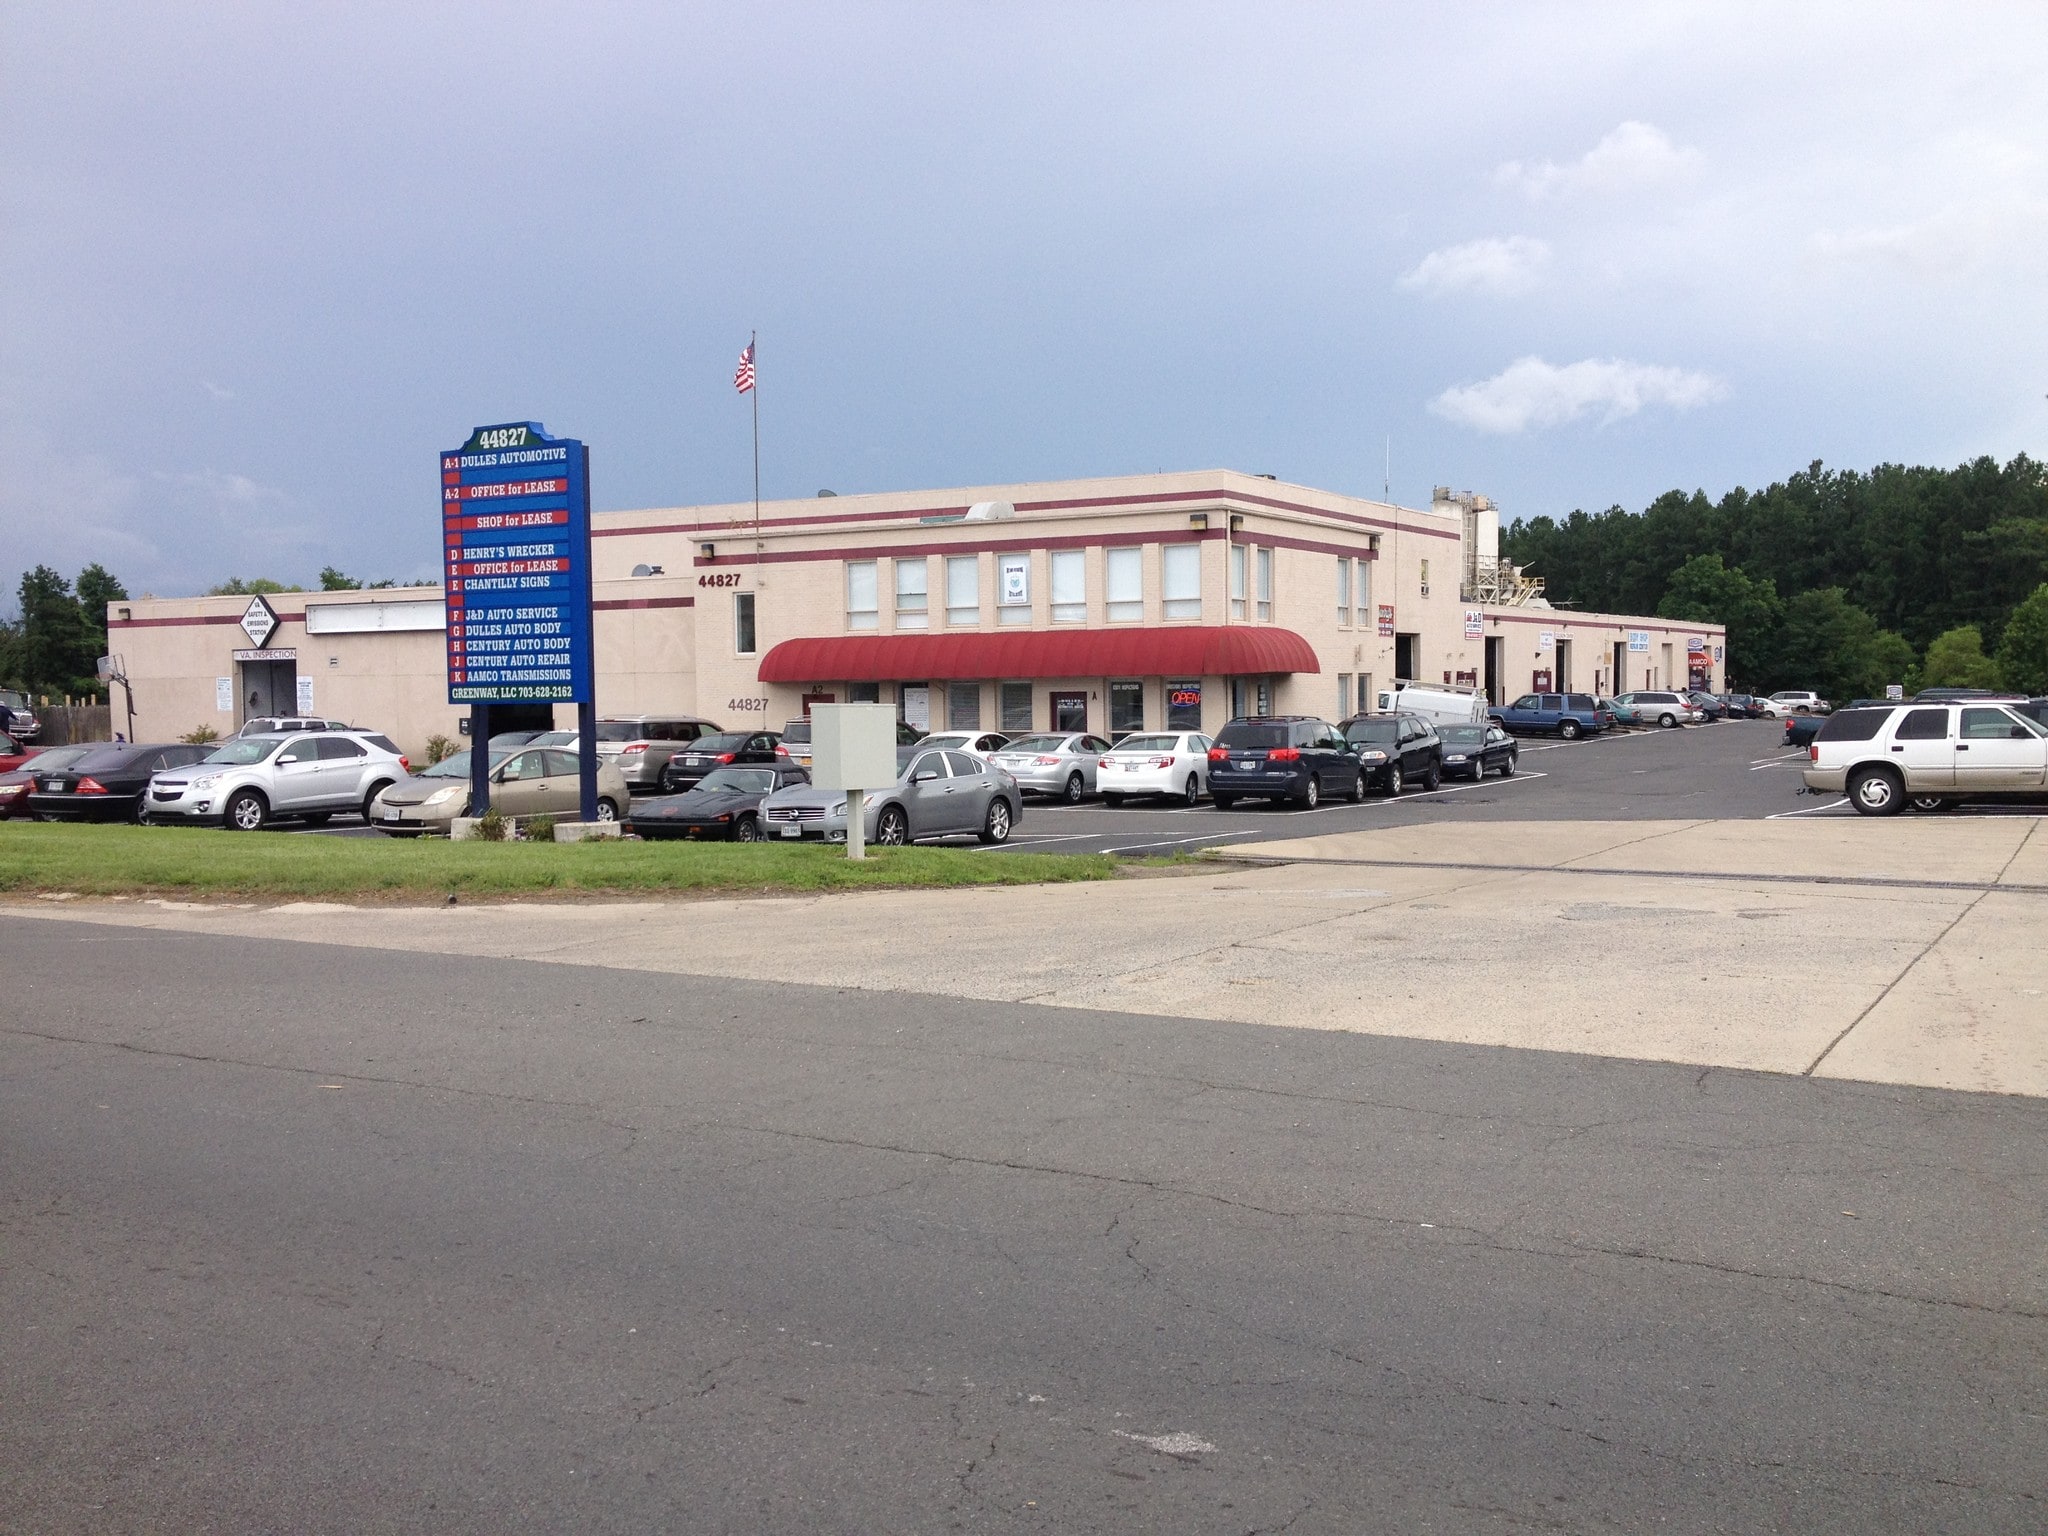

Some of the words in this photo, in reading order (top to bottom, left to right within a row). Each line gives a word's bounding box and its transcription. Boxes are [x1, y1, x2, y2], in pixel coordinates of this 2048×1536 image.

[480, 428, 527, 449] 44827
[445, 458, 459, 468] A-1
[461, 454, 496, 467] DULLES
[500, 448, 566, 464] AUTOMOTIVE
[445, 489, 459, 499] A-2
[471, 485, 505, 498] OFFICE
[509, 484, 521, 495] for
[525, 481, 556, 493] LEASE
[477, 517, 503, 528] SHOP
[506, 516, 518, 526] for
[522, 513, 552, 525] LEASE
[452, 550, 458, 560] D
[463, 547, 504, 559] HENRY'S
[508, 544, 555, 557] WRECKER
[452, 565, 458, 575] E
[474, 564, 508, 575] OFFICE
[511, 562, 524, 573] for
[528, 561, 558, 571] LEASE
[453, 580, 458, 591] E
[465, 578, 518, 590] CHANTILLY
[521, 576, 550, 588] SIGNS
[699, 574, 741, 587] 44827
[453, 611, 459, 621] F
[466, 610, 484, 621] J&D
[487, 609, 513, 620] AUTO
[516, 608, 558, 619] SERVICE
[454, 626, 460, 636] G
[466, 625, 502, 636] DULLES
[505, 624, 531, 635] AUTO
[534, 623, 561, 634] BODY
[454, 642, 460, 651] H
[466, 640, 511, 651] CENTURY
[514, 639, 541, 650] AUTO
[544, 638, 571, 650] BODY
[455, 657, 460, 667] J
[467, 656, 508, 667] CENTURY
[510, 655, 535, 666] AUTO
[538, 654, 571, 665] REPAIR
[455, 672, 461, 682] K
[467, 671, 498, 682] AAMCO
[501, 669, 571, 681] TRANSMISSIONS
[452, 688, 500, 700] GREENWAY,
[501, 687, 517, 698] LLC
[518, 686, 572, 698] 703-628-2162
[812, 685, 823, 695] A2
[1092, 692, 1097, 701] A
[729, 699, 769, 711] 44827
[1172, 692, 1201, 705] OPEN
